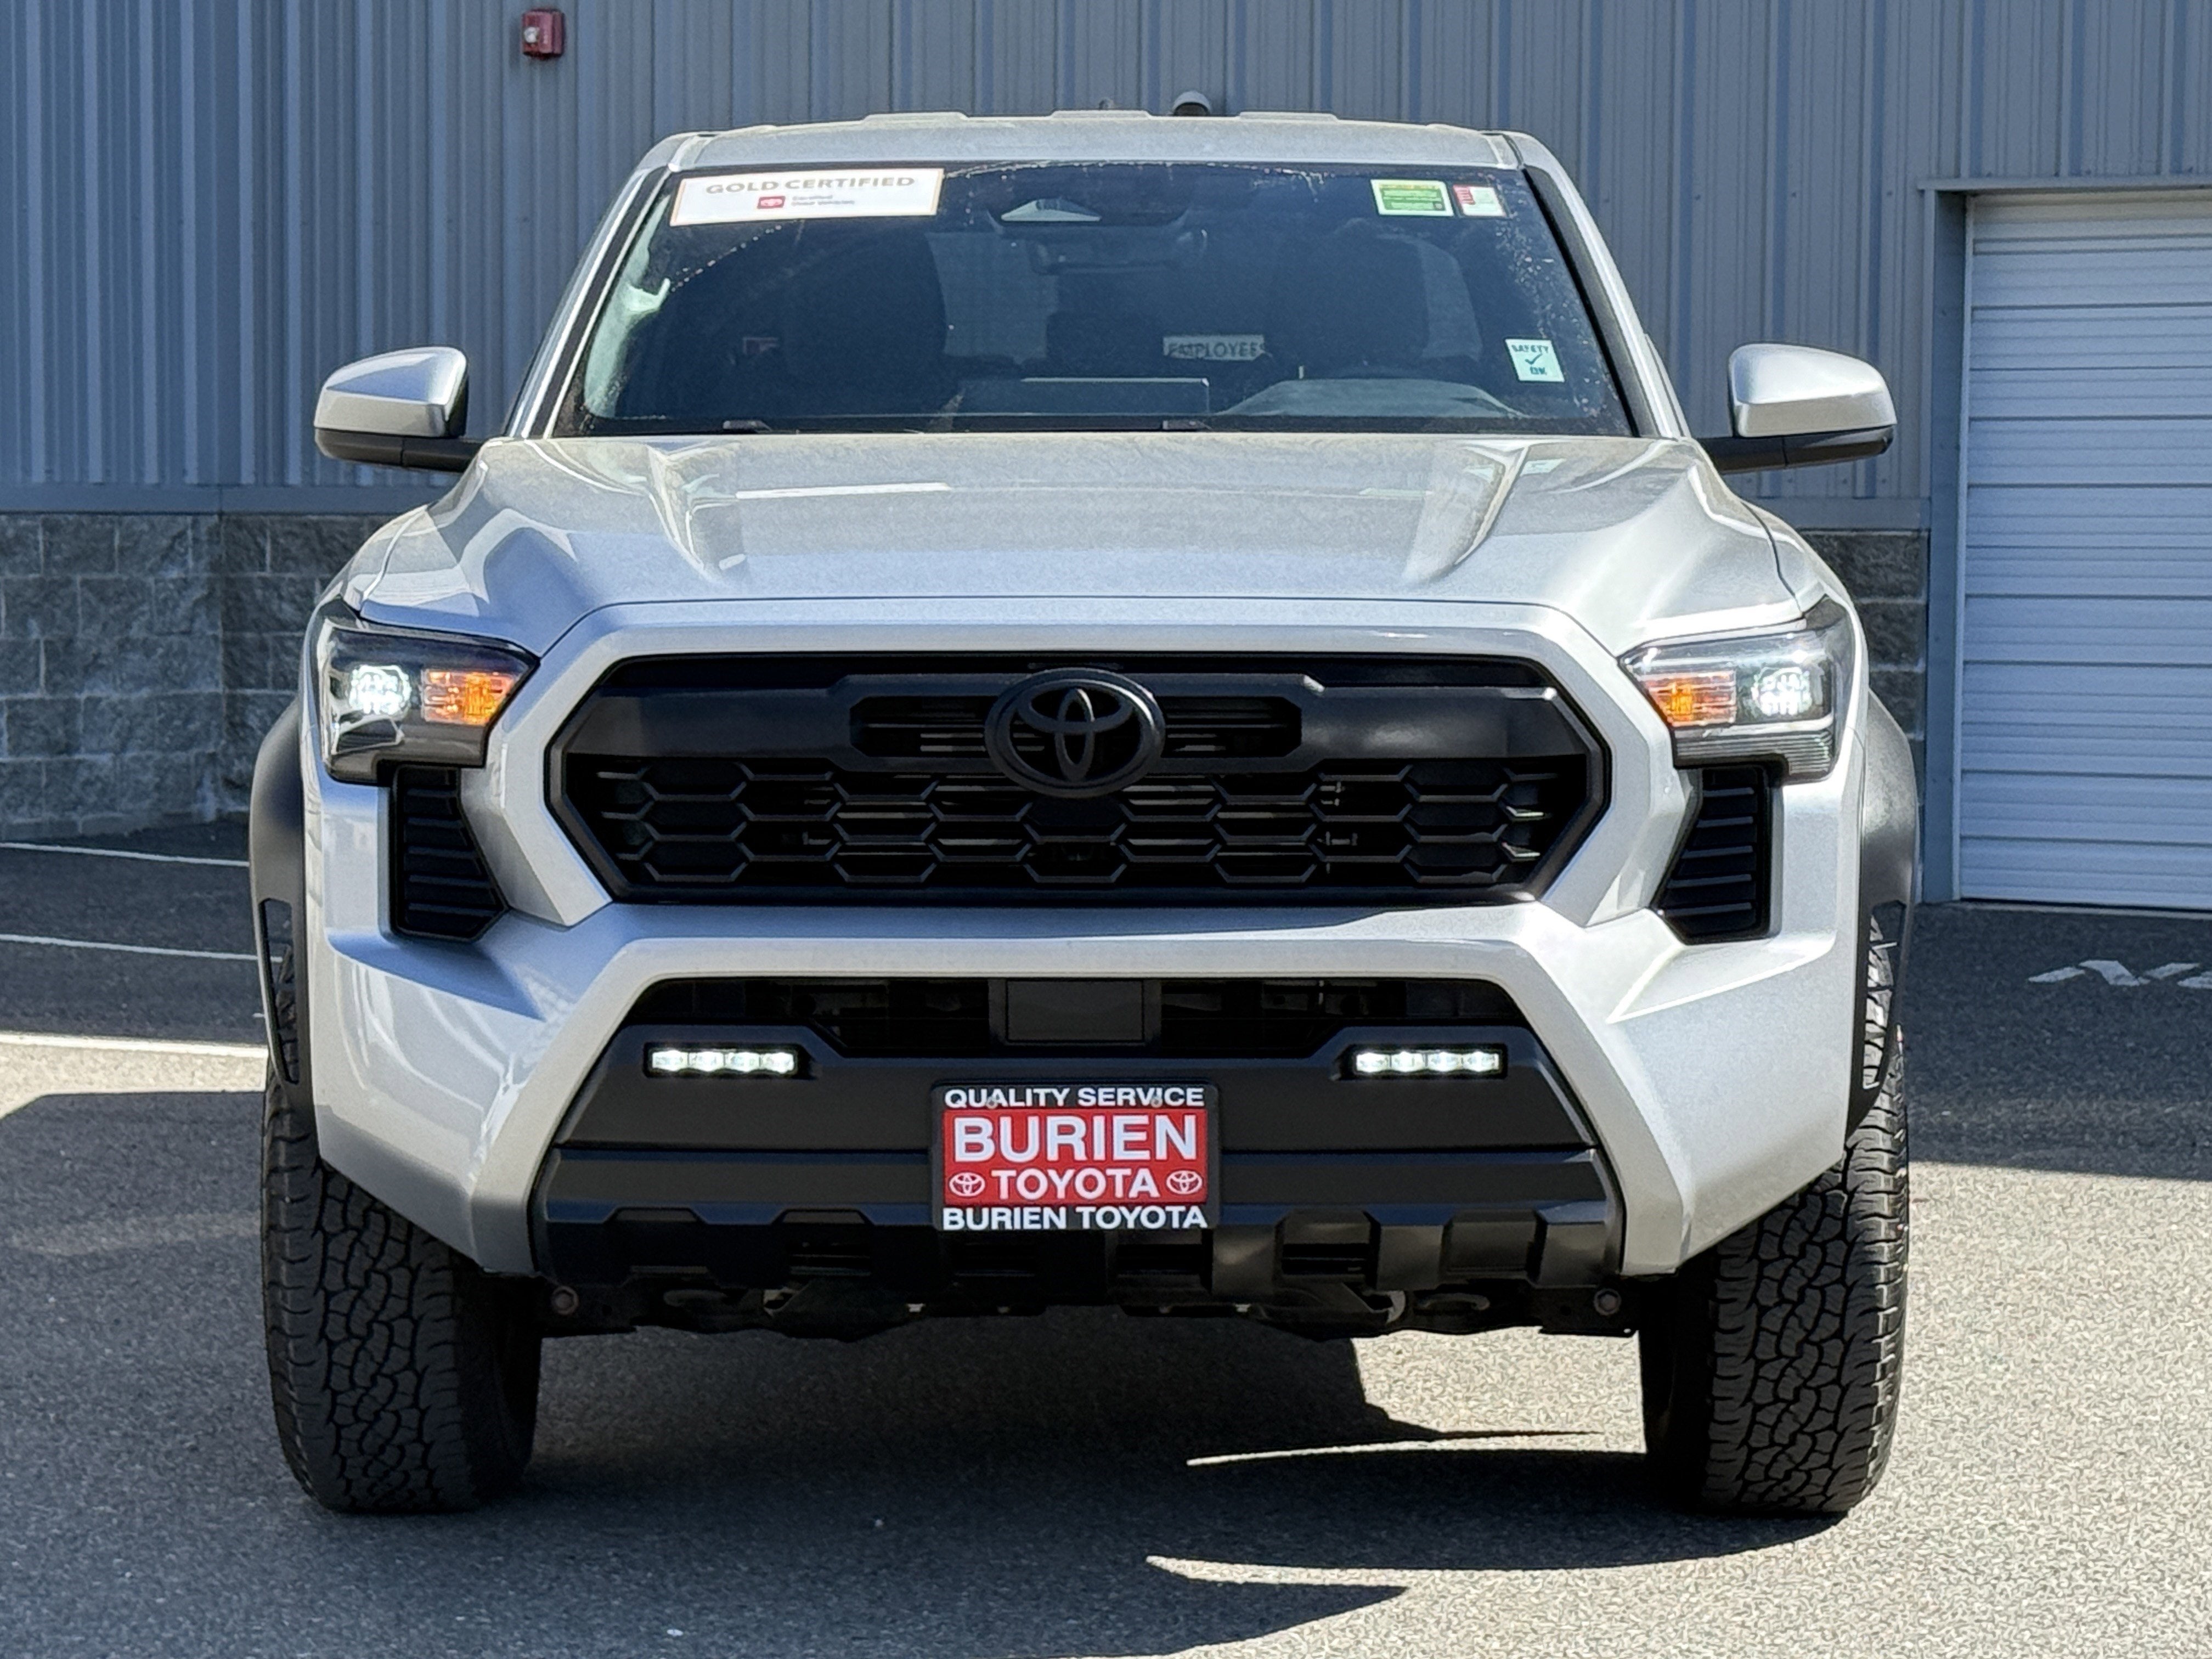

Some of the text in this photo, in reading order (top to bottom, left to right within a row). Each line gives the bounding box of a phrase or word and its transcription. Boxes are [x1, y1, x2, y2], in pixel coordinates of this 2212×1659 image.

[706, 177, 915, 194] GOLD CERTIFIED
[945, 1087, 1204, 1108] QUALITY SERVICE
[954, 1114, 1197, 1162] BURIEN
[991, 1167, 1160, 1200] TOYOTA
[943, 1206, 1207, 1230] BURIEN TOYOTA
